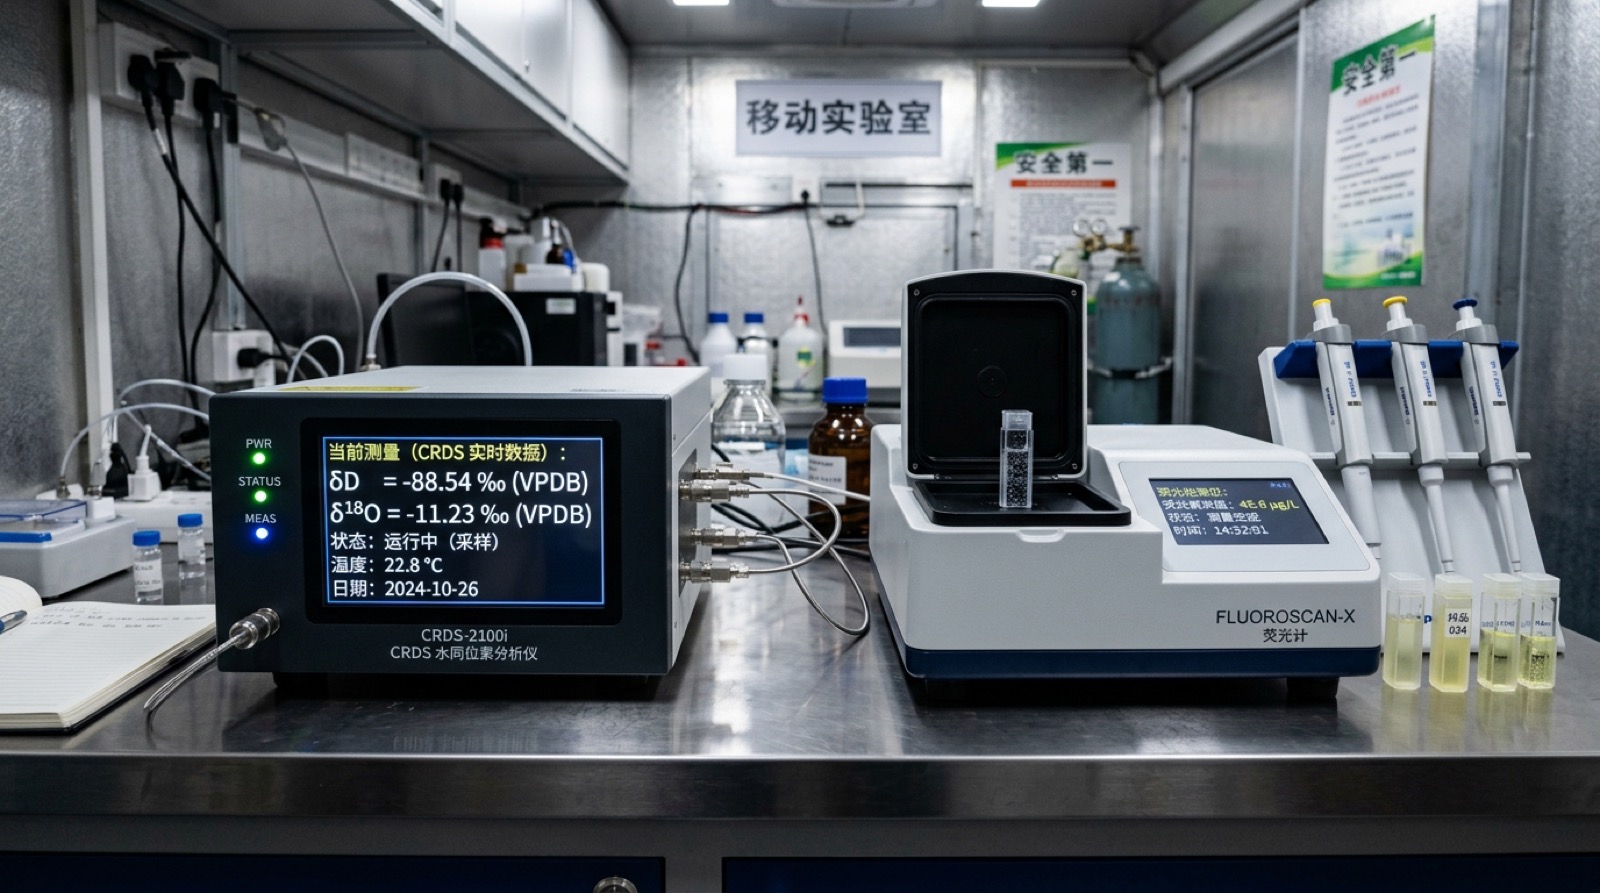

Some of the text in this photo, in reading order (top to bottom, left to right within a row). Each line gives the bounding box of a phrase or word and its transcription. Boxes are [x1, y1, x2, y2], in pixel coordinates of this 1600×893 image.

[1342, 47, 1416, 97] 安全第一
[746, 99, 931, 135] 移动实验室
[1015, 150, 1114, 175] 安全第一
[245, 438, 272, 449] PWR
[238, 476, 281, 487] STATUS
[329, 470, 588, 496] δD = -88.54 ‰ (VPDB)
[245, 513, 277, 524] MEAS
[387, 508, 401, 519] =
[406, 504, 475, 524] -11.23
[480, 504, 509, 524] ‰
[515, 502, 592, 528] (VPDB)
[1216, 608, 1356, 624] FLUOROSCAN-X
[421, 629, 508, 643] CRDS-2100i
[1263, 628, 1308, 643] 荧光计
[390, 646, 431, 659] CRDS
